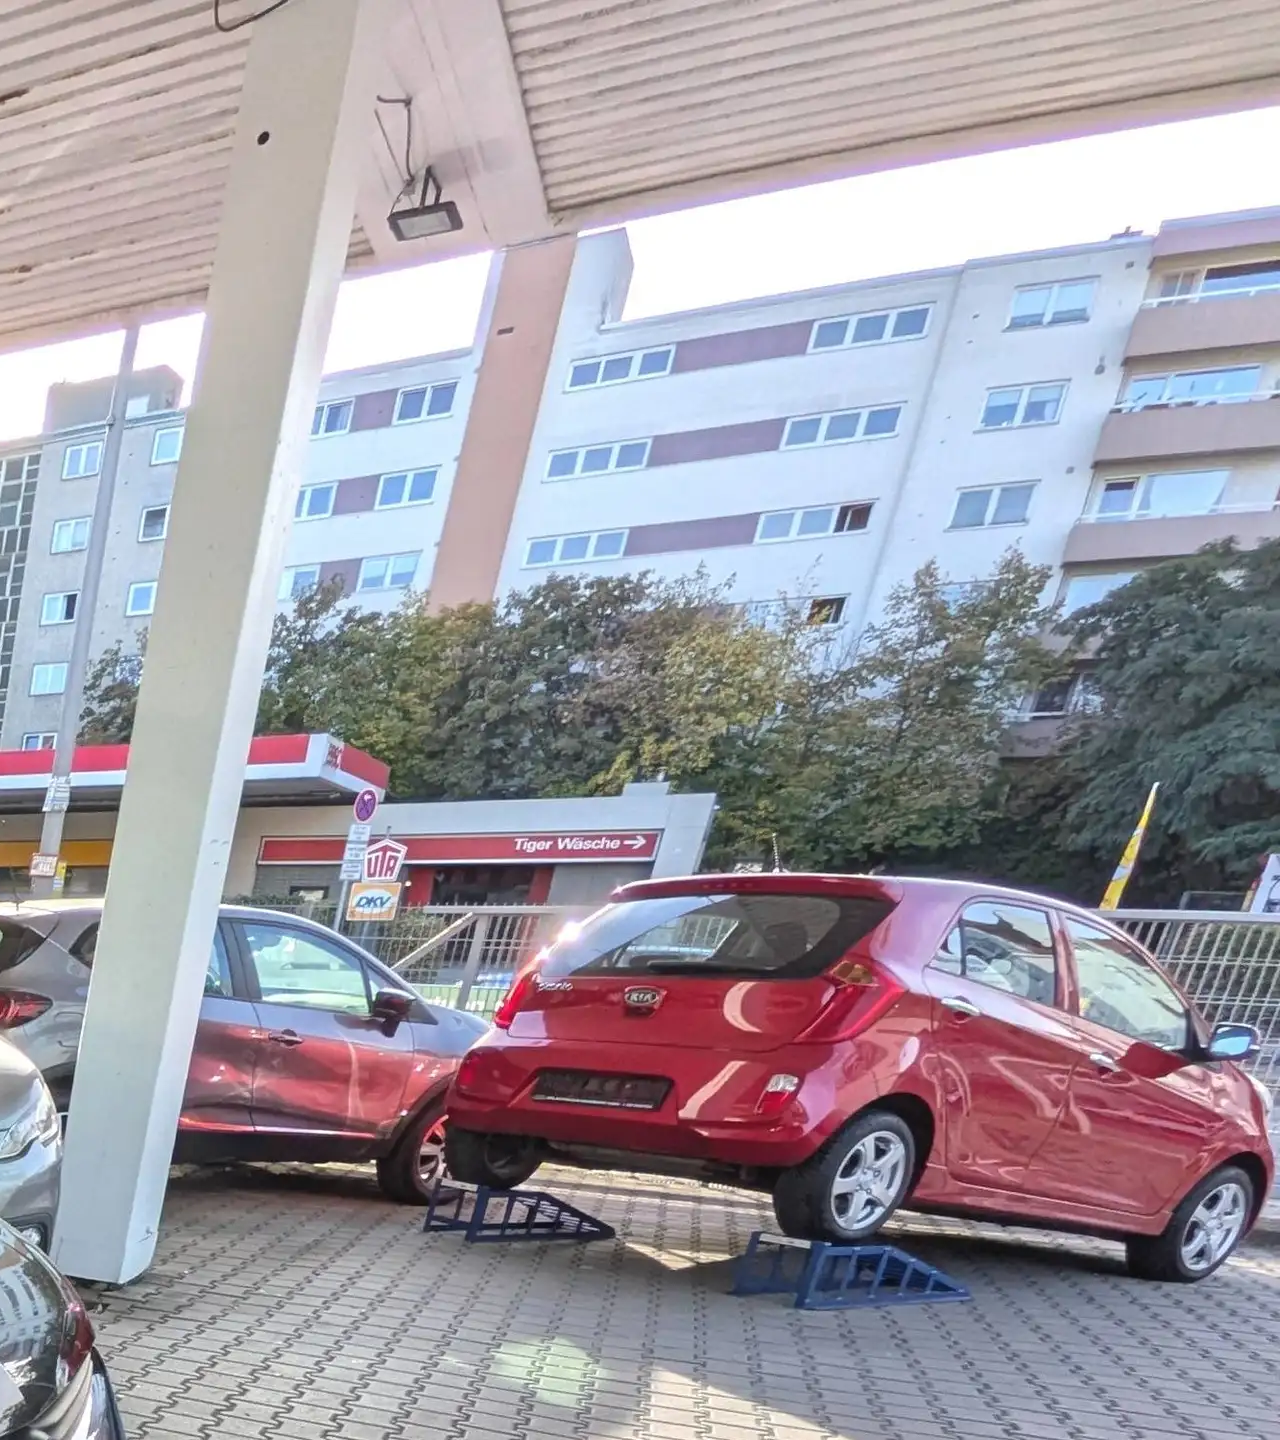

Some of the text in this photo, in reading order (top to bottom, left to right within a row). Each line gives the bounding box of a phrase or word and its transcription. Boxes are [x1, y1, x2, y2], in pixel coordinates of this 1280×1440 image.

[513, 836, 621, 853] Tiger Wäsche
[354, 895, 392, 908] DKV
[630, 991, 653, 1002] KIA
